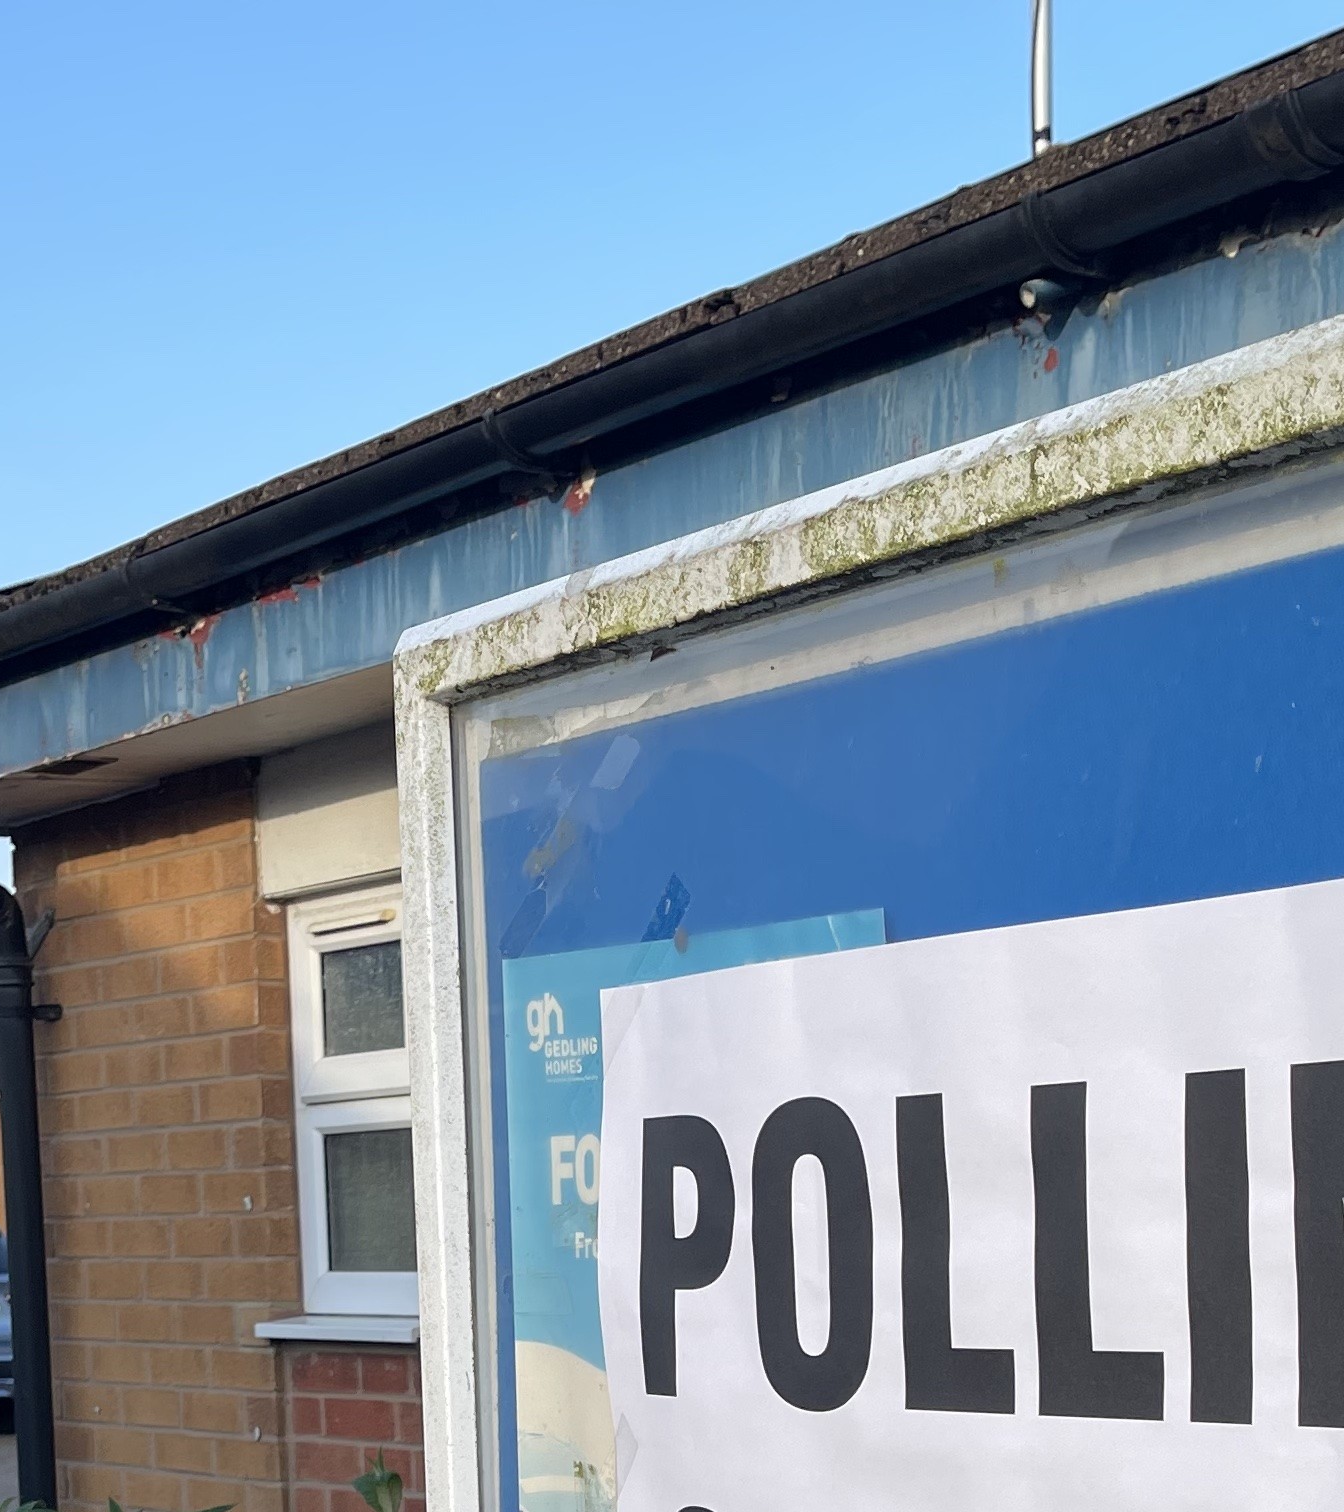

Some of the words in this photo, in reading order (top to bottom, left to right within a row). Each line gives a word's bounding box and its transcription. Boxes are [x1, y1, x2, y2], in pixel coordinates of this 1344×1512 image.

[544, 1036, 598, 1058] GEDLING
[545, 1059, 583, 1076] HOMES
[551, 1134, 600, 1205] FO
